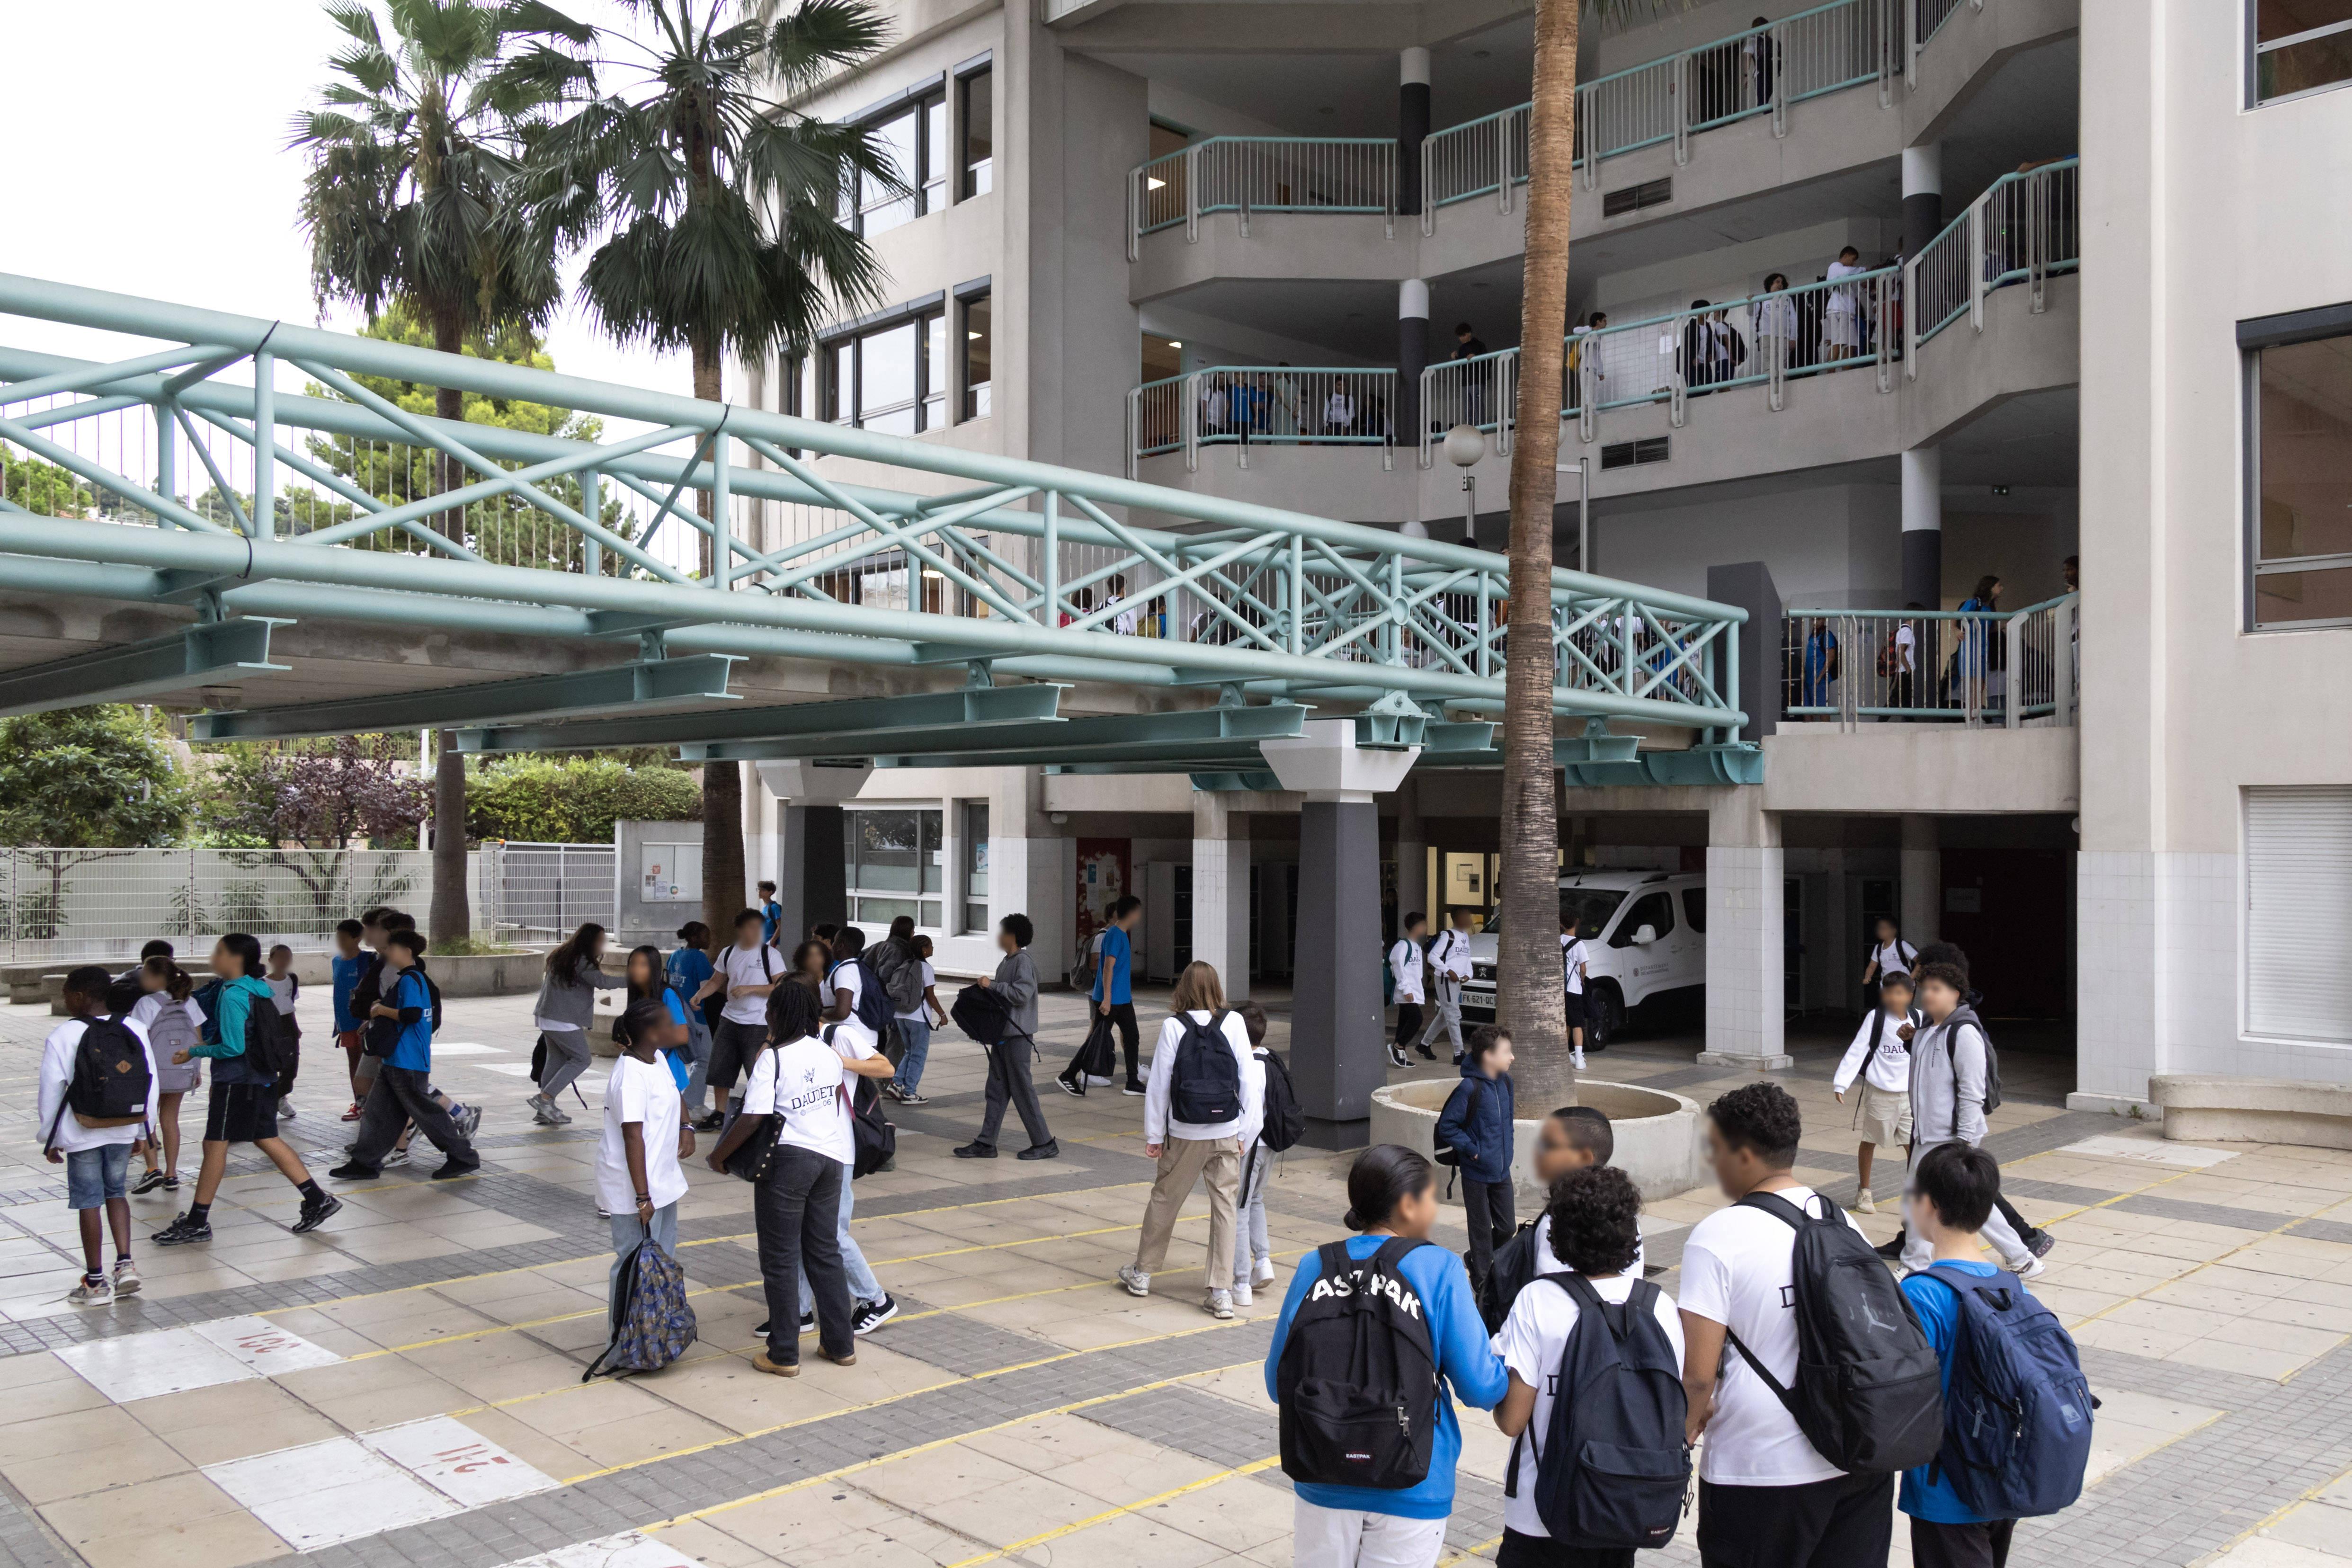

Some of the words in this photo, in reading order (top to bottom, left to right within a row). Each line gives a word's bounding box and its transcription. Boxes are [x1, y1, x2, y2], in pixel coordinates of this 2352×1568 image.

[1883, 1045, 1905, 1053] DAU
[791, 1085, 834, 1109] DAUDET
[1306, 1270, 1421, 1320] ASPAK
